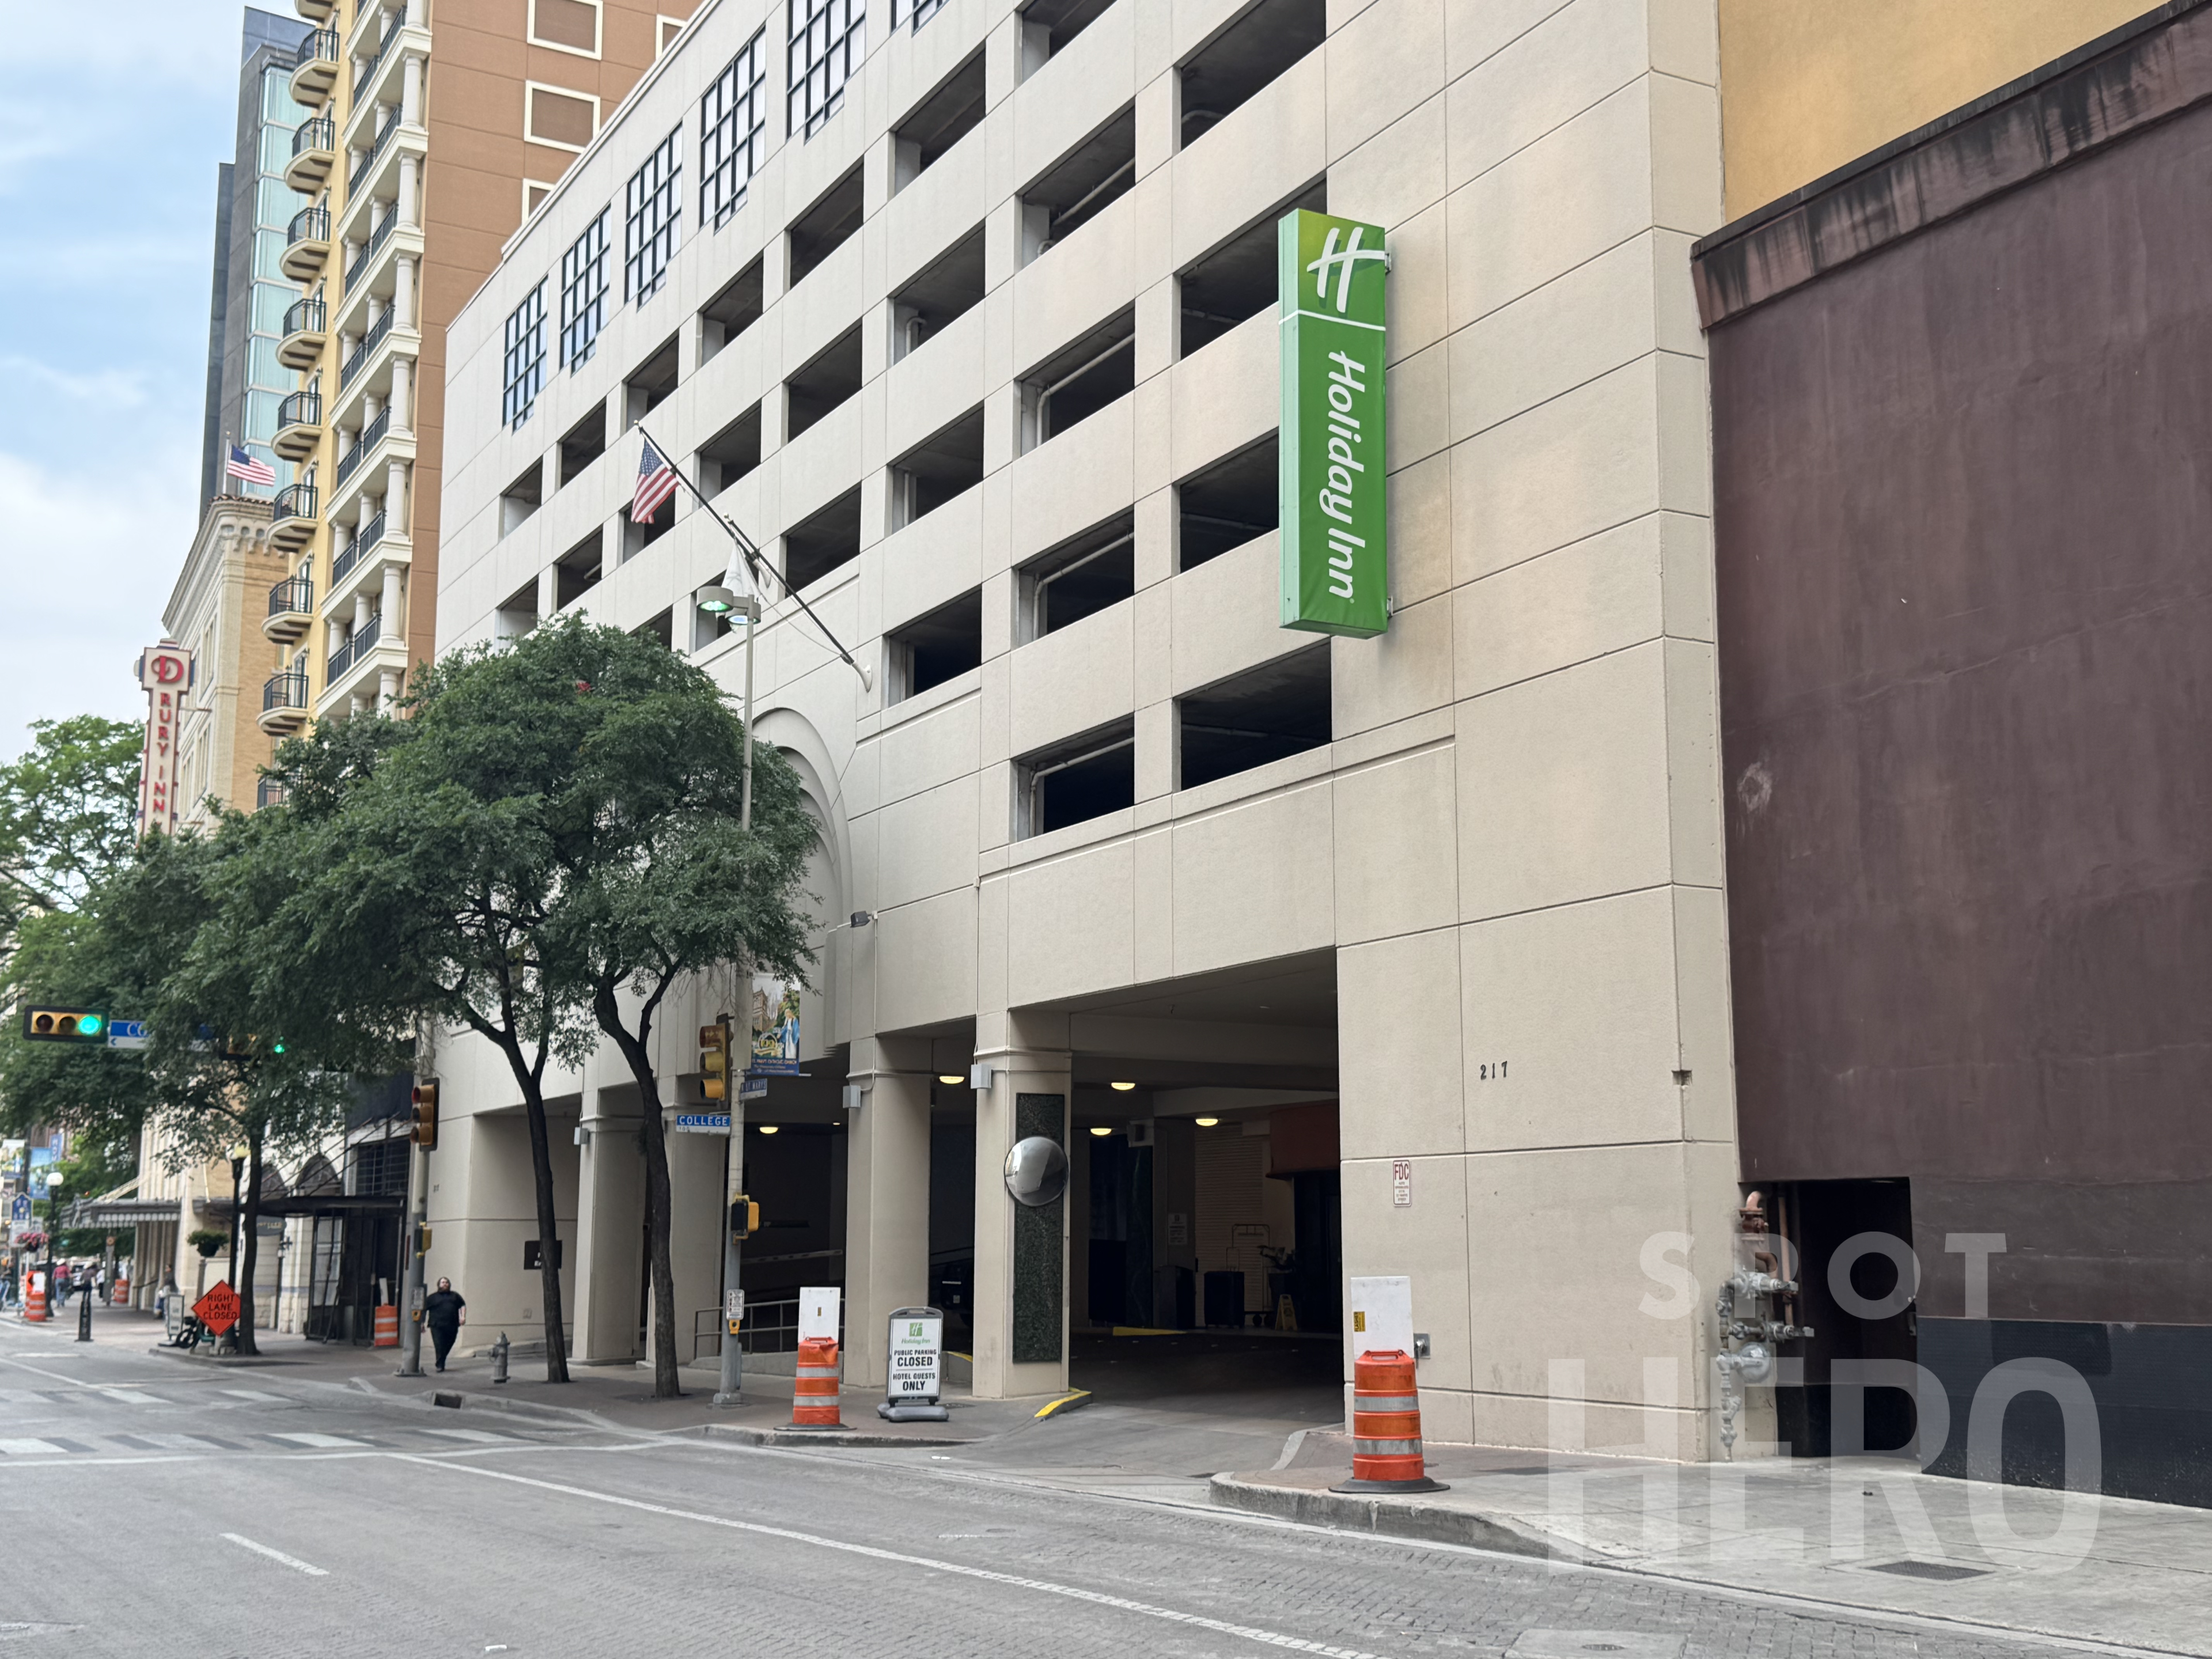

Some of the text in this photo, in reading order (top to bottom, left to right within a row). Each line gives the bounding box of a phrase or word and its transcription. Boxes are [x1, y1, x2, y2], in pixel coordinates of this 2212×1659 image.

[1319, 350, 1366, 599] Holiday Inn
[151, 655, 184, 812] DRURY INN
[1480, 1060, 1508, 1081] 217
[679, 1116, 728, 1126] COLLEGE
[1394, 1162, 1409, 1180] FDC
[207, 1294, 234, 1302] RIGHT
[209, 1303, 233, 1311] LANE
[203, 1312, 237, 1320] CLOSED
[897, 1356, 933, 1367] CLOSED
[903, 1380, 926, 1391] ONLY
